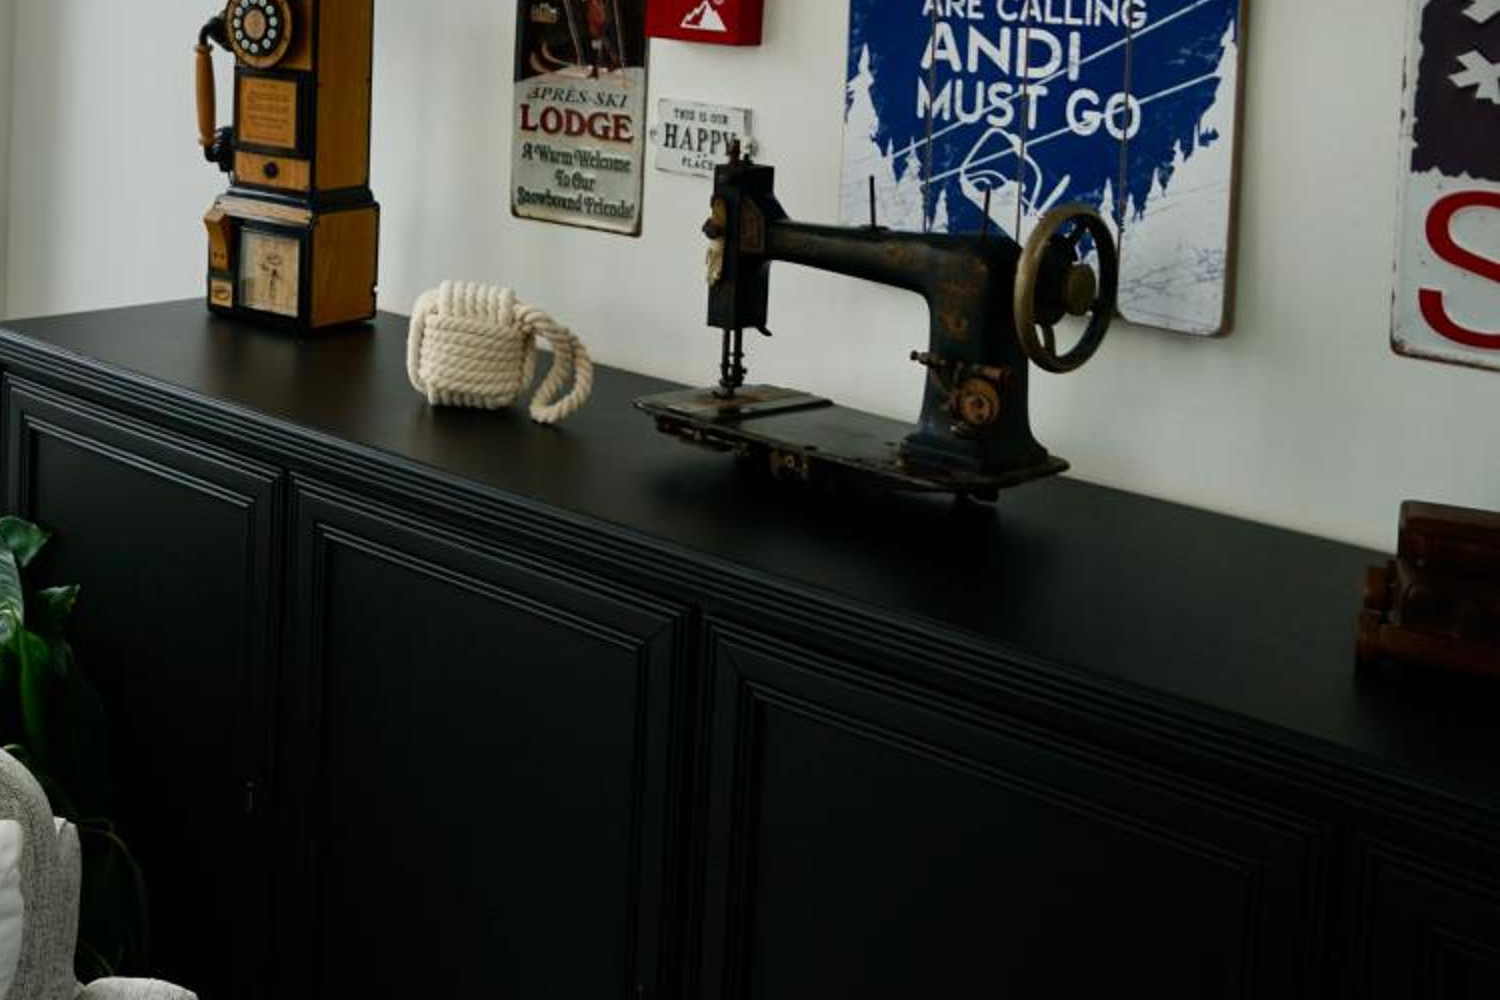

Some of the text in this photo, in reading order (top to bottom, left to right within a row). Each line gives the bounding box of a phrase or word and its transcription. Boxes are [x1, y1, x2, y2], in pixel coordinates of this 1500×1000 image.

[921, 22, 1062, 80] AND
[520, 103, 635, 143] LODGE
[916, 77, 1142, 140] MUST GO
